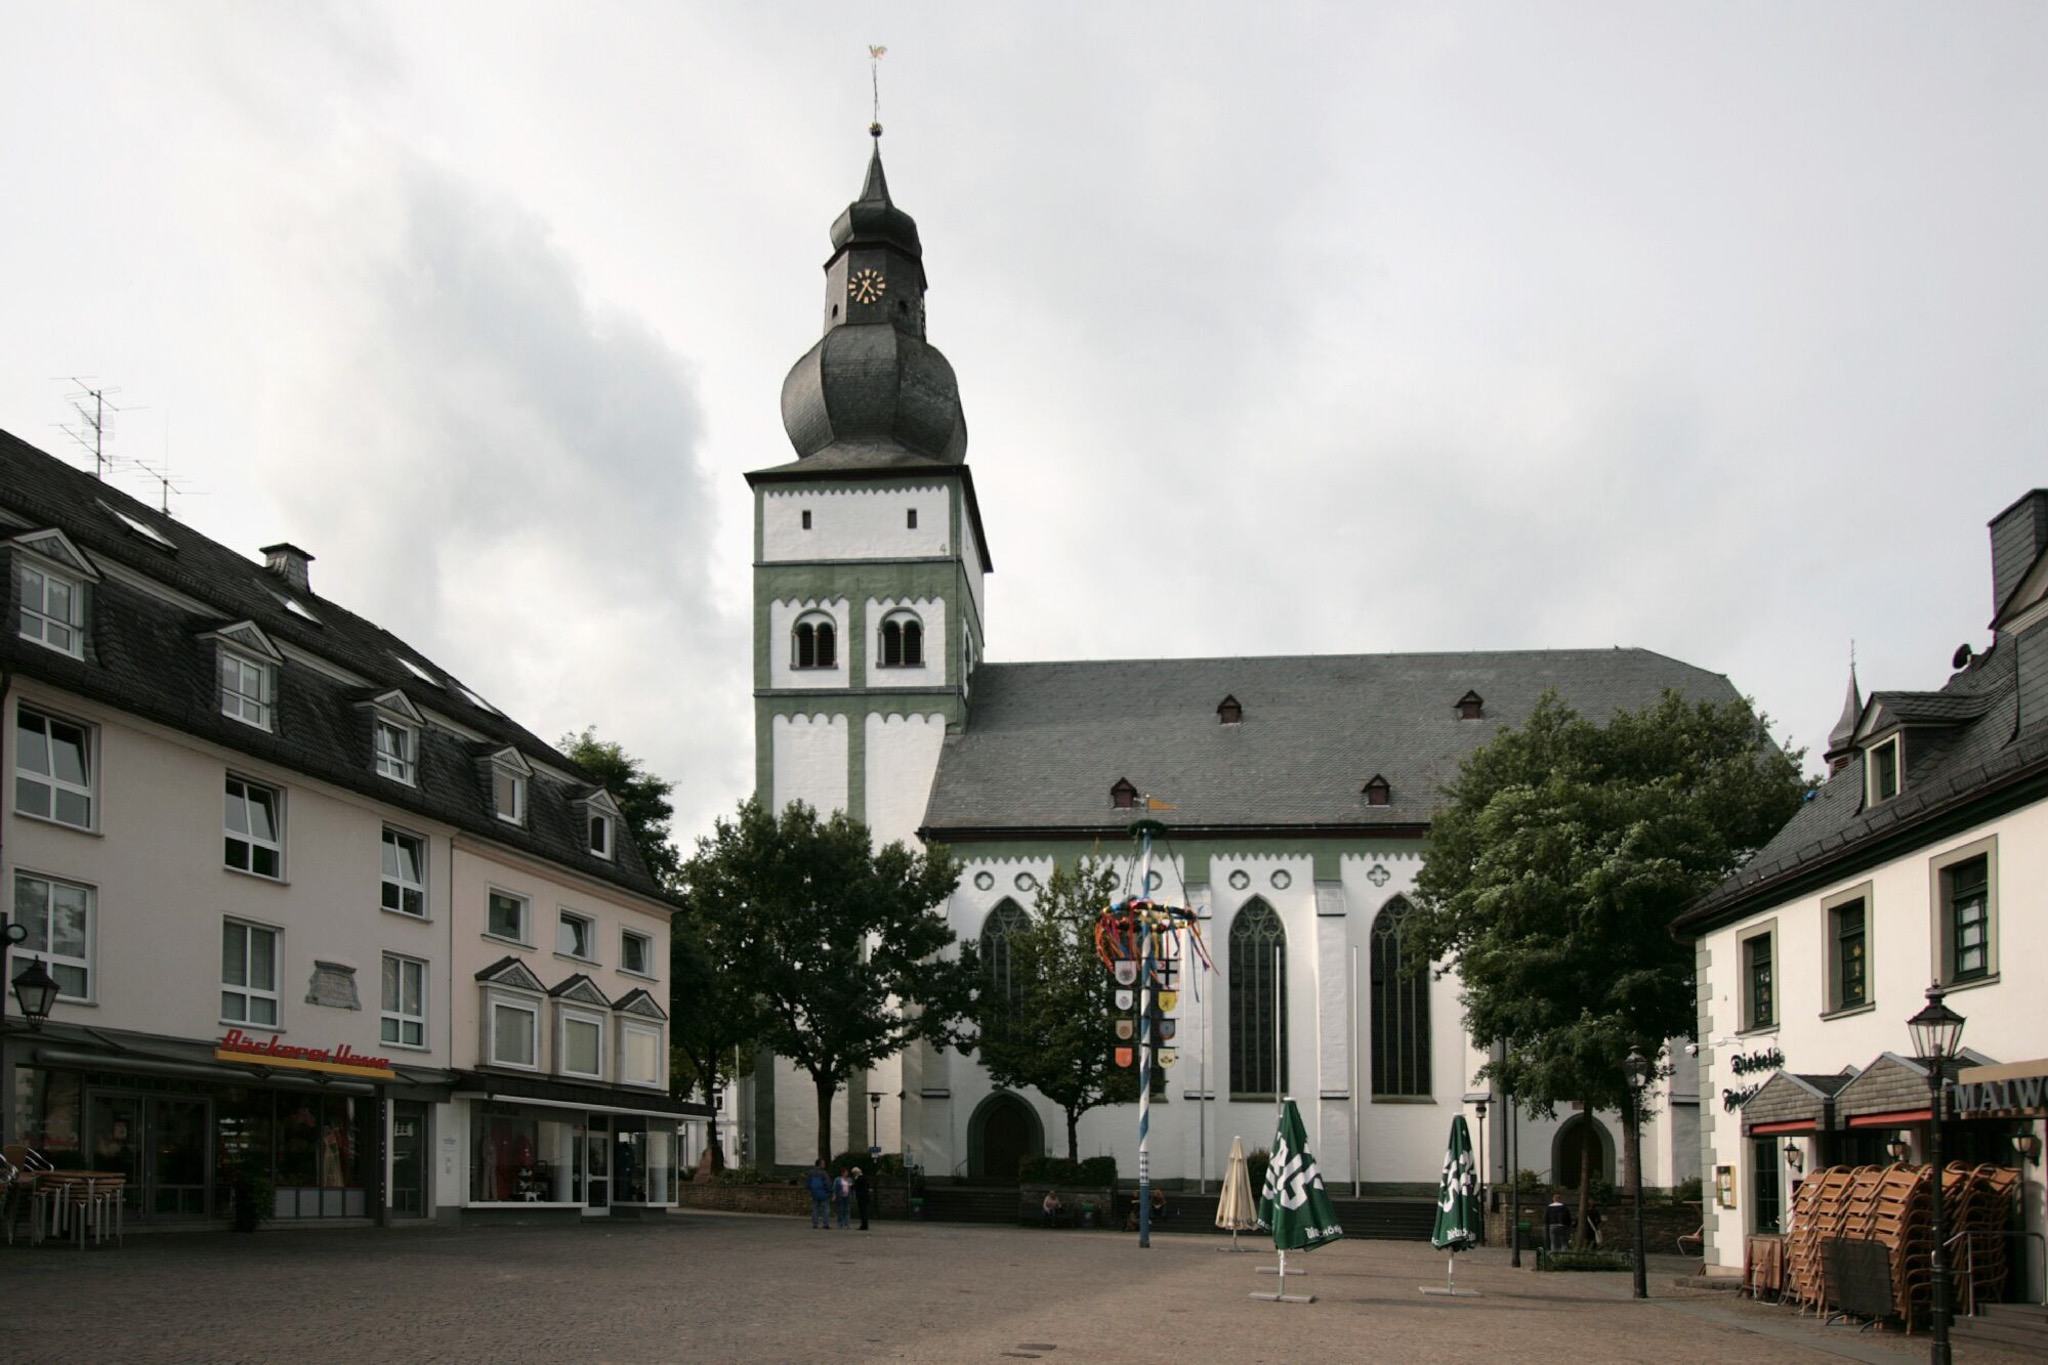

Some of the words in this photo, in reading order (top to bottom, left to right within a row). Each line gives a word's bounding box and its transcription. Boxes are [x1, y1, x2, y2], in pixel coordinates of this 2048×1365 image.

[221, 1029, 331, 1062] Bäckerei
[1731, 1047, 1785, 1076] Diebels
[1952, 1076, 2048, 1113] MAIW
